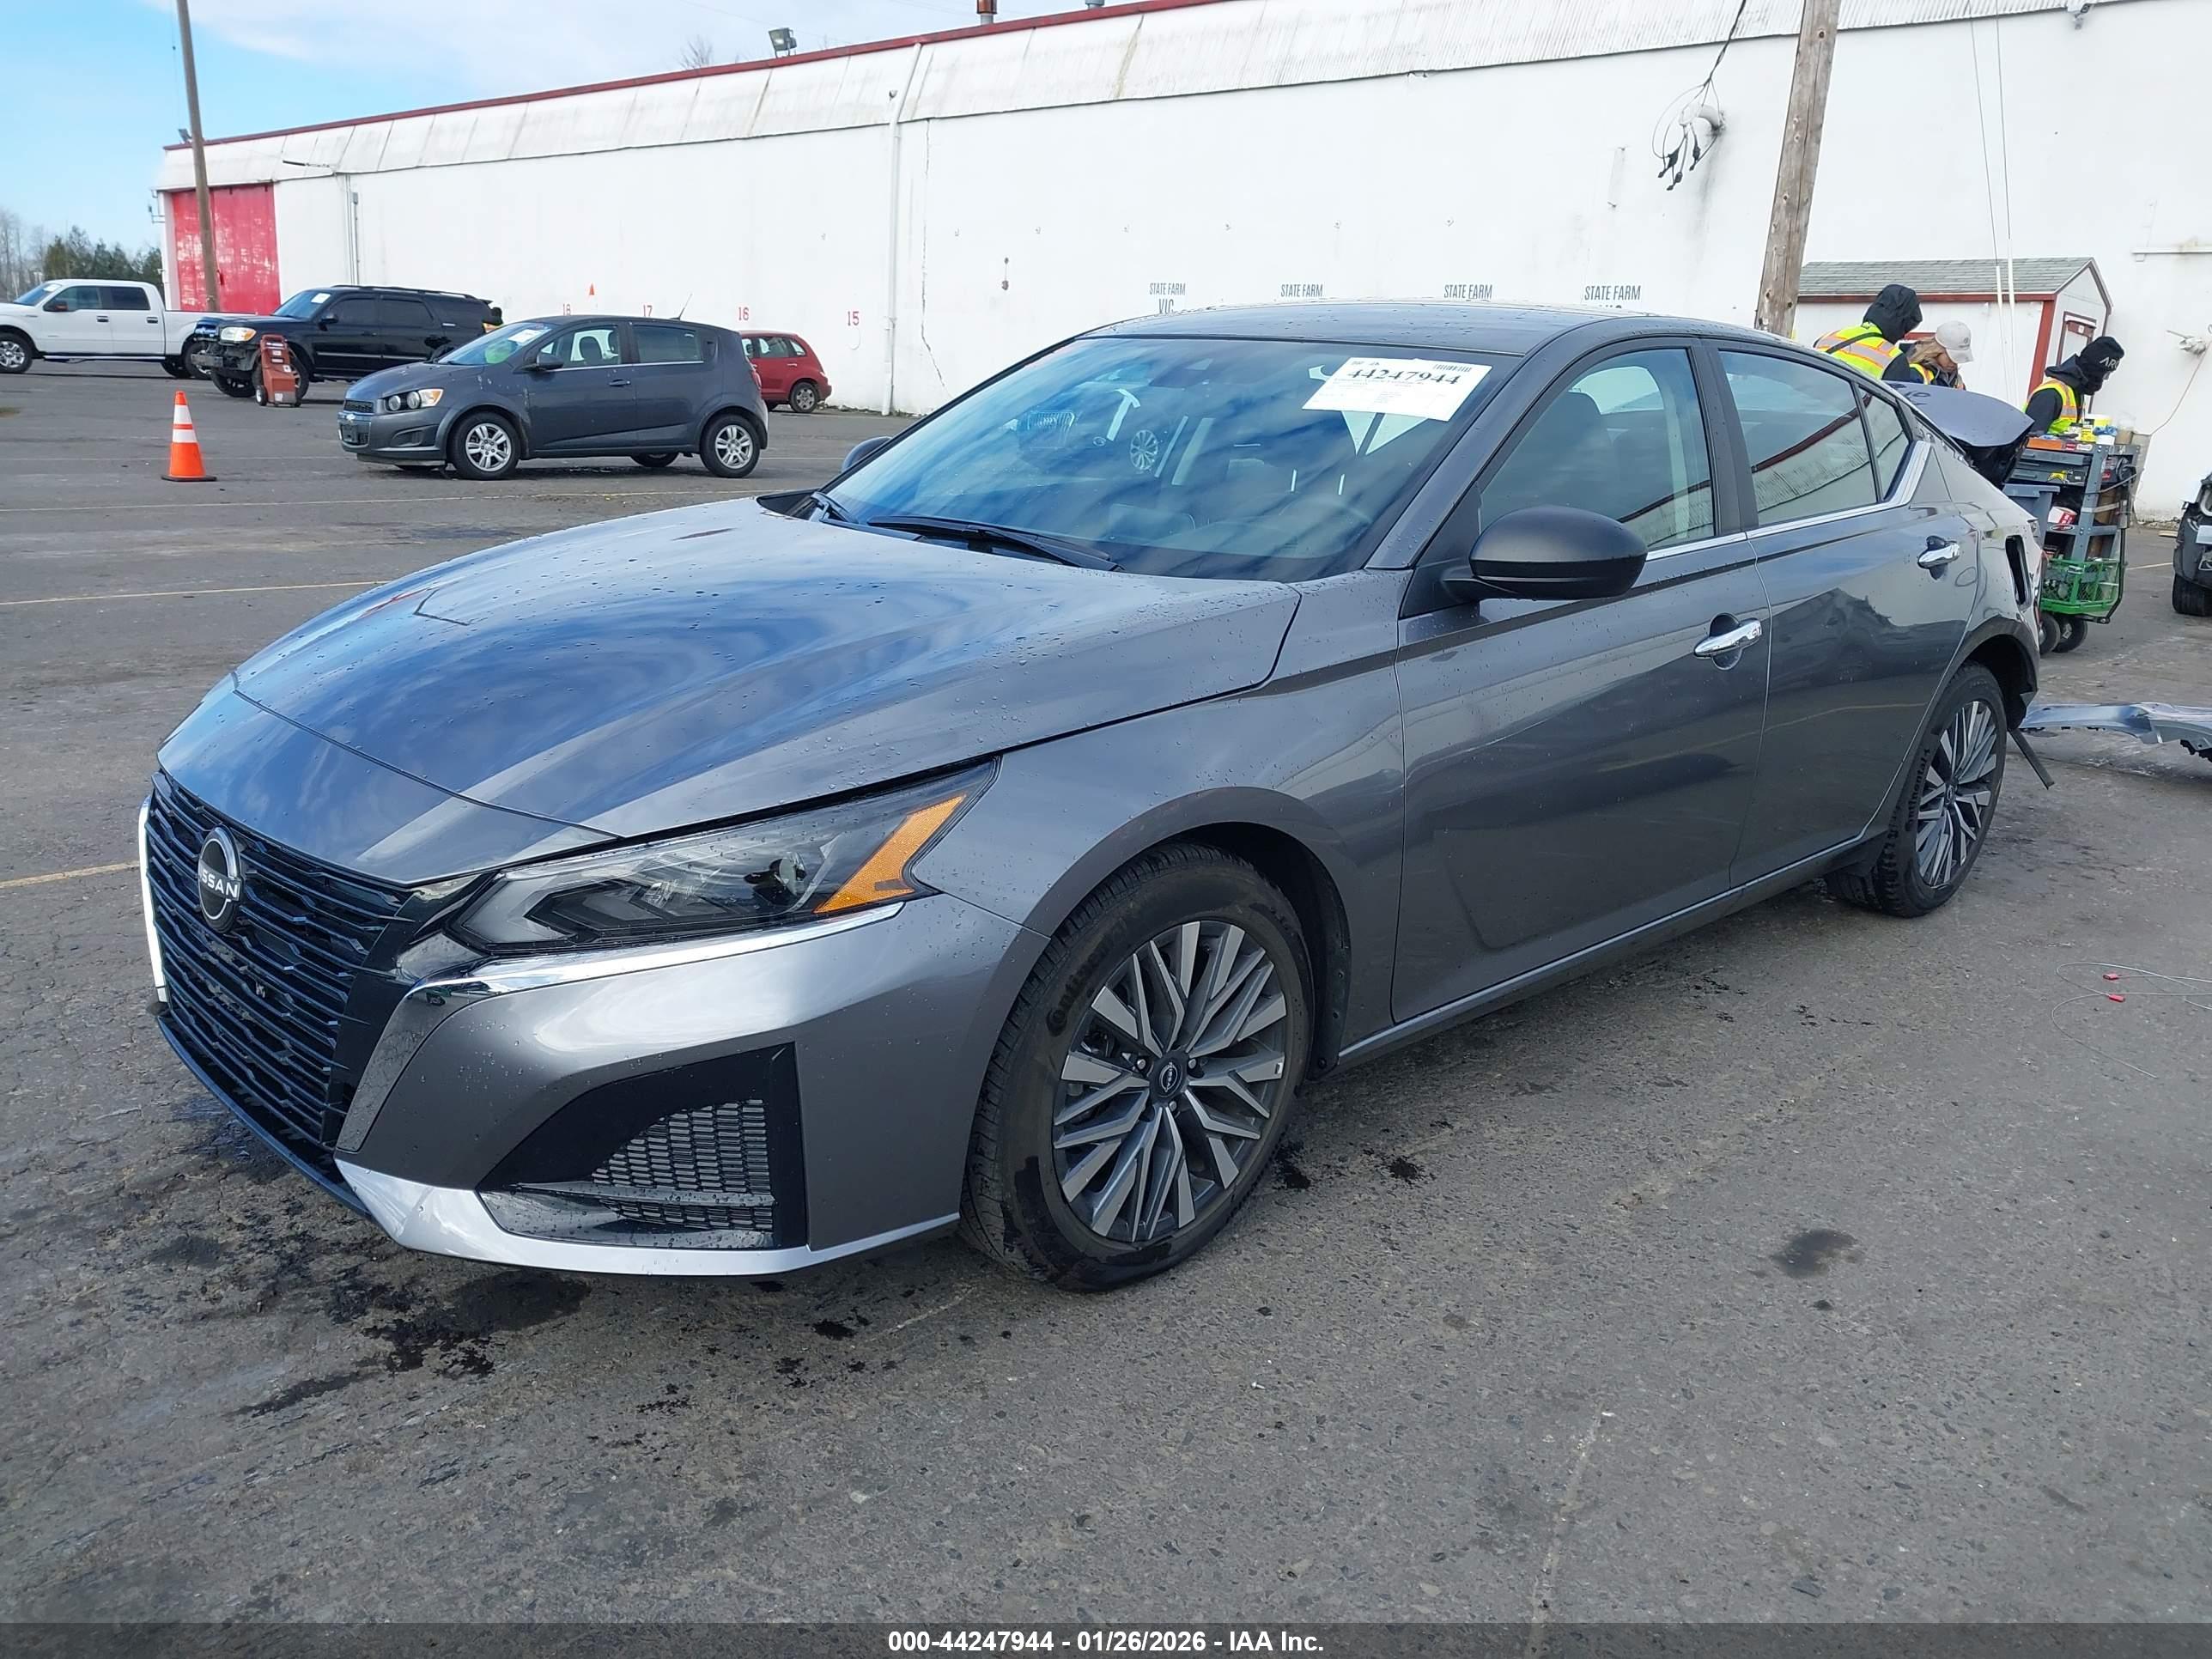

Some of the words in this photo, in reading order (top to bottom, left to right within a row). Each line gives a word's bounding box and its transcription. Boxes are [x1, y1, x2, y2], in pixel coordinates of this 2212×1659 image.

[1149, 283, 1167, 295] STATE
[1168, 283, 1186, 296] FARM
[1280, 283, 1301, 297] STATE
[1302, 283, 1323, 298] FARM
[1443, 284, 1467, 298] STATE
[1468, 284, 1492, 299] FARM
[1583, 285, 1612, 301] STATE
[1613, 285, 1642, 301] FARM
[642, 305, 653, 317] 17
[738, 307, 750, 321] 16
[847, 311, 860, 326] 15
[1348, 368, 1462, 385] 44247944
[200, 867, 239, 899] SSAN
